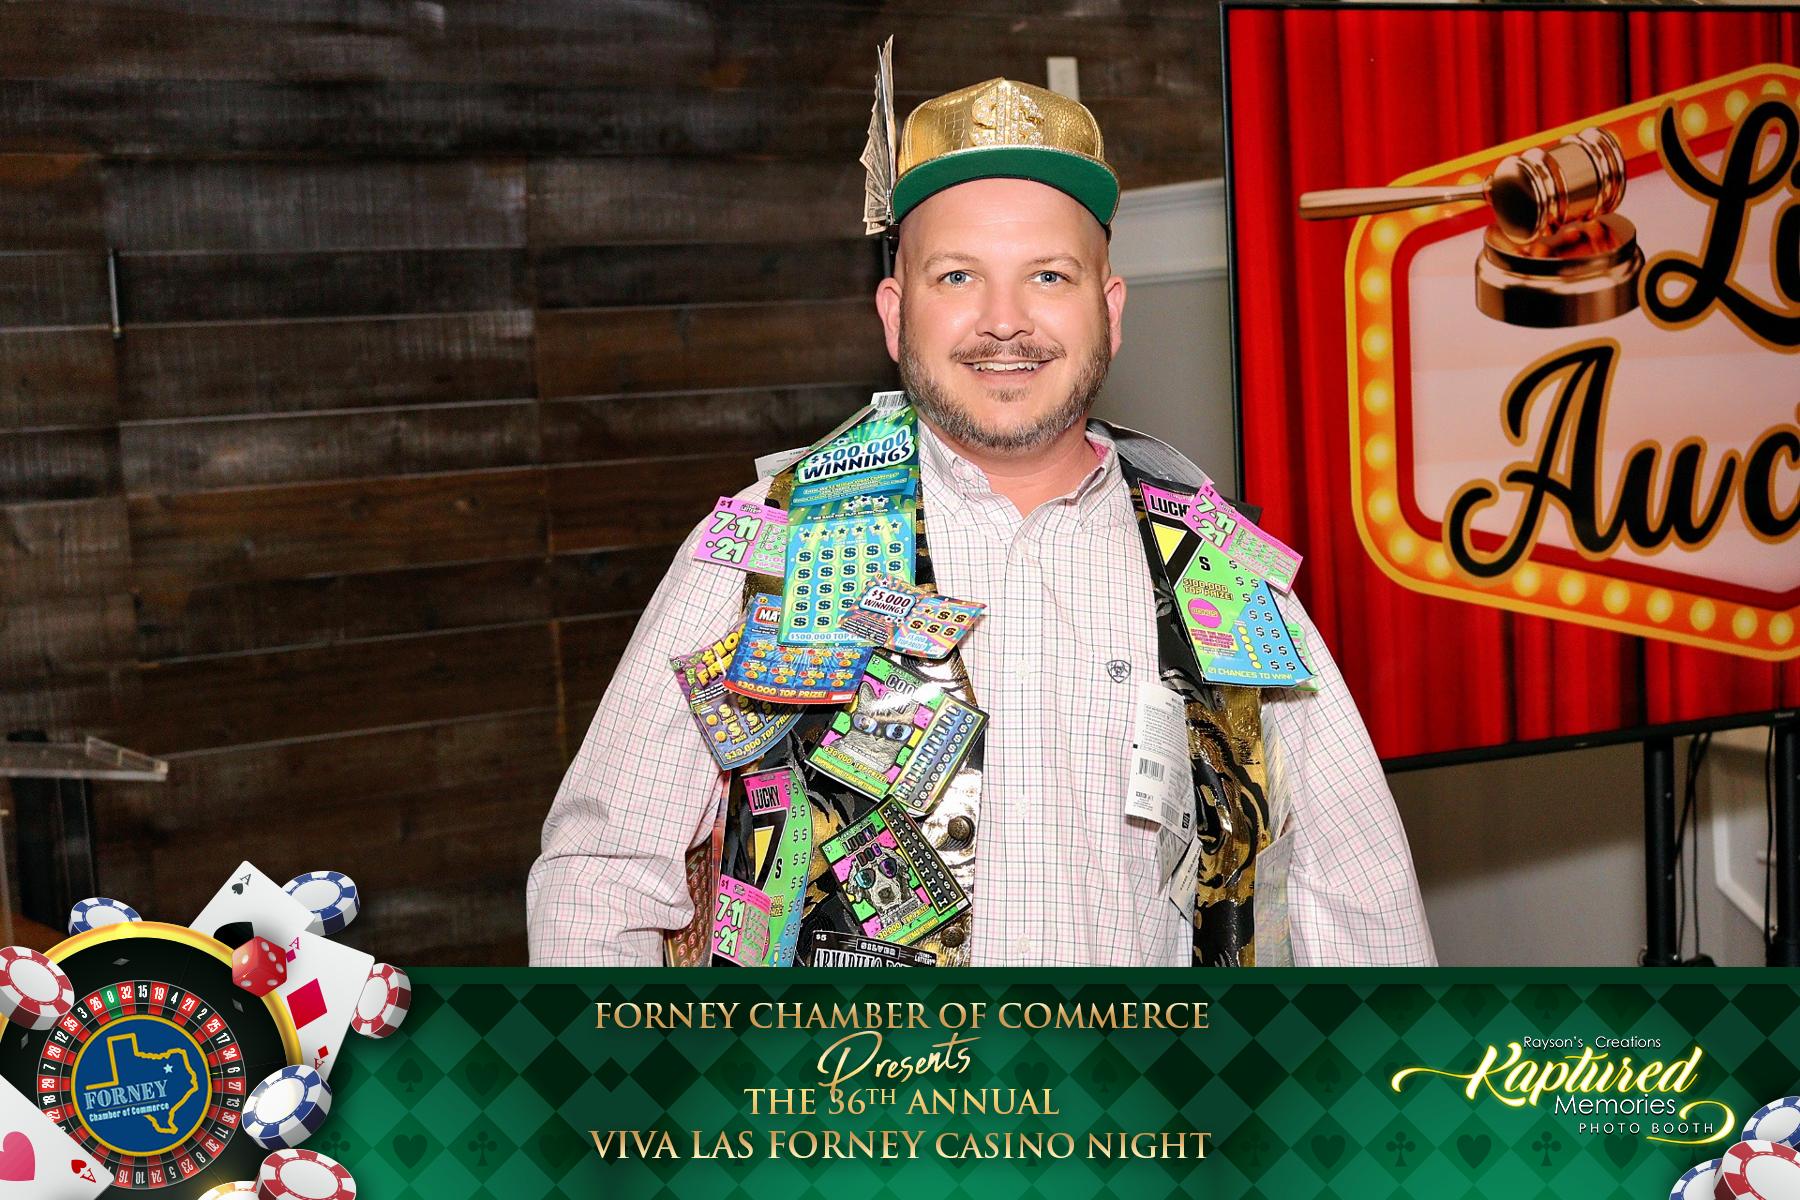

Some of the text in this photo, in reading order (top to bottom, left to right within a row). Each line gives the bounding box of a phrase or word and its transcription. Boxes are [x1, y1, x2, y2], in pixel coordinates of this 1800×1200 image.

[804, 441, 911, 480] WINNINGS
[1150, 495, 1190, 517] LUCK
[863, 599, 905, 614] WINNINGS
[1218, 668, 1257, 678] CHANCES
[780, 689, 796, 697] TOP
[760, 725, 775, 740] TOP
[751, 786, 780, 810] LUCKY
[842, 823, 878, 856] LUCKY
[856, 843, 882, 867] DOG
[860, 942, 896, 957] SILVER
